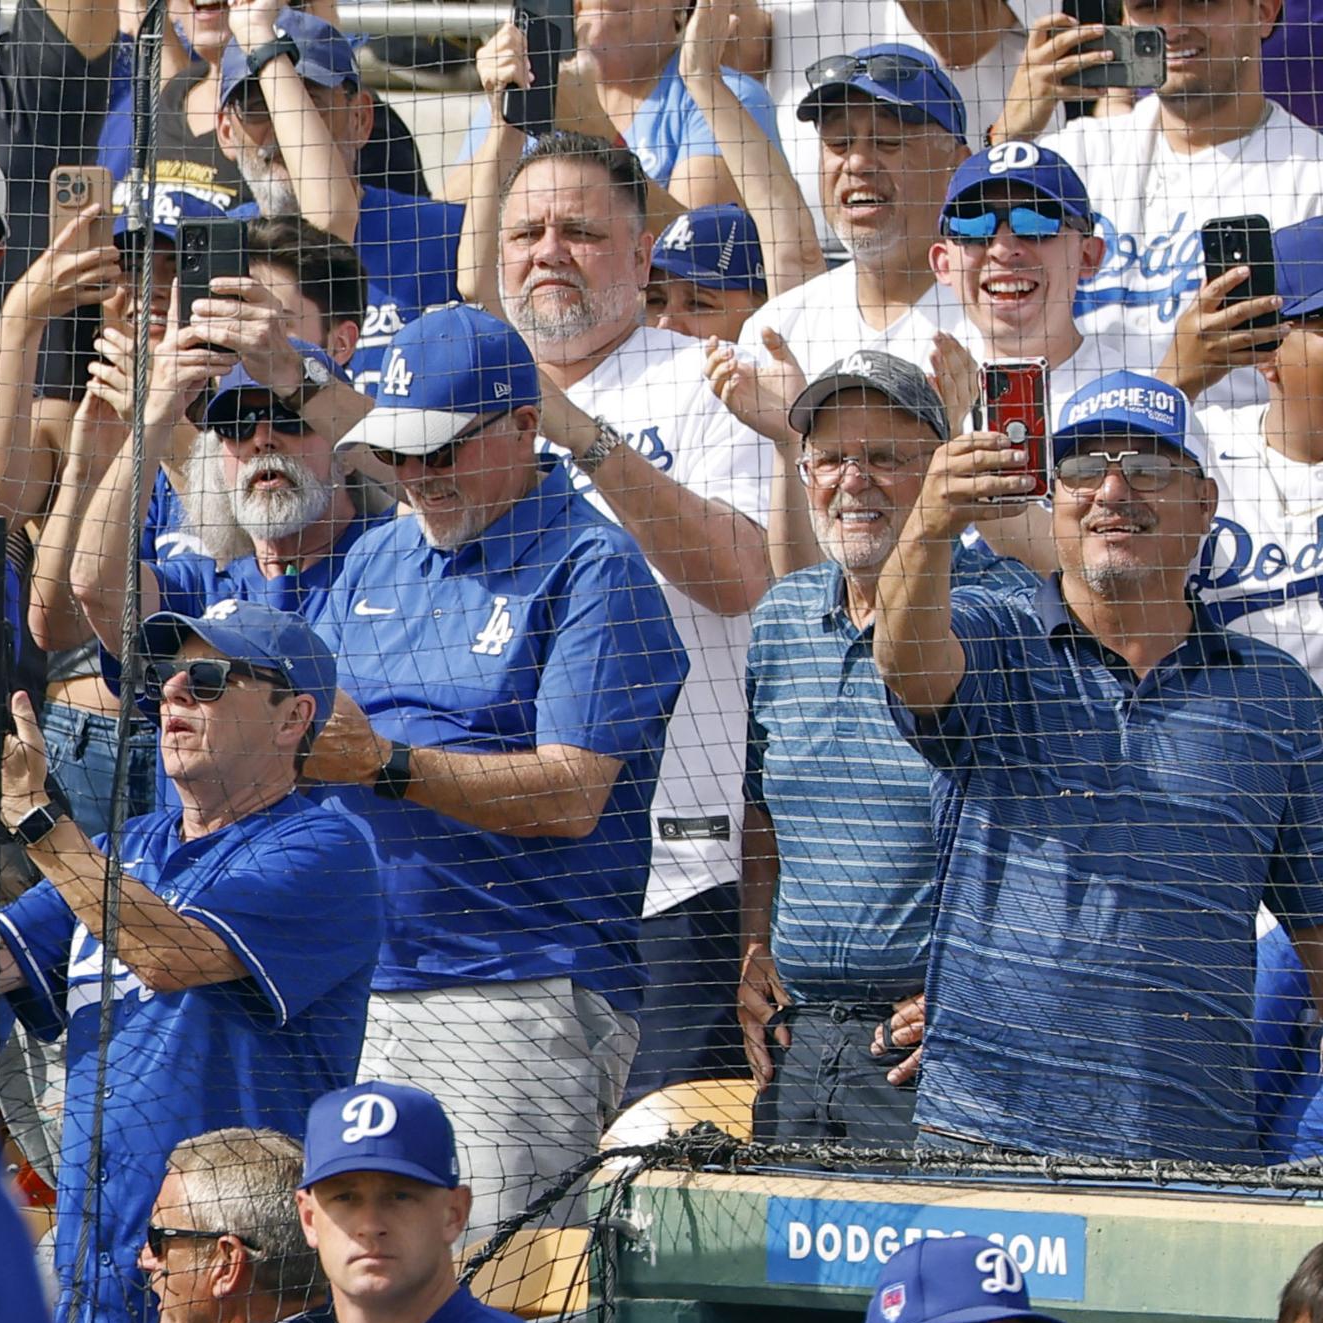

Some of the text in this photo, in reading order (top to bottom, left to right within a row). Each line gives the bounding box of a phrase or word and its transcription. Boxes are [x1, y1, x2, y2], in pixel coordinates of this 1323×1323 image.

[987, 141, 1040, 174] D
[384, 349, 413, 396] LA
[471, 597, 514, 655] LA
[342, 1094, 397, 1144] D
[975, 1248, 1023, 1294] D
